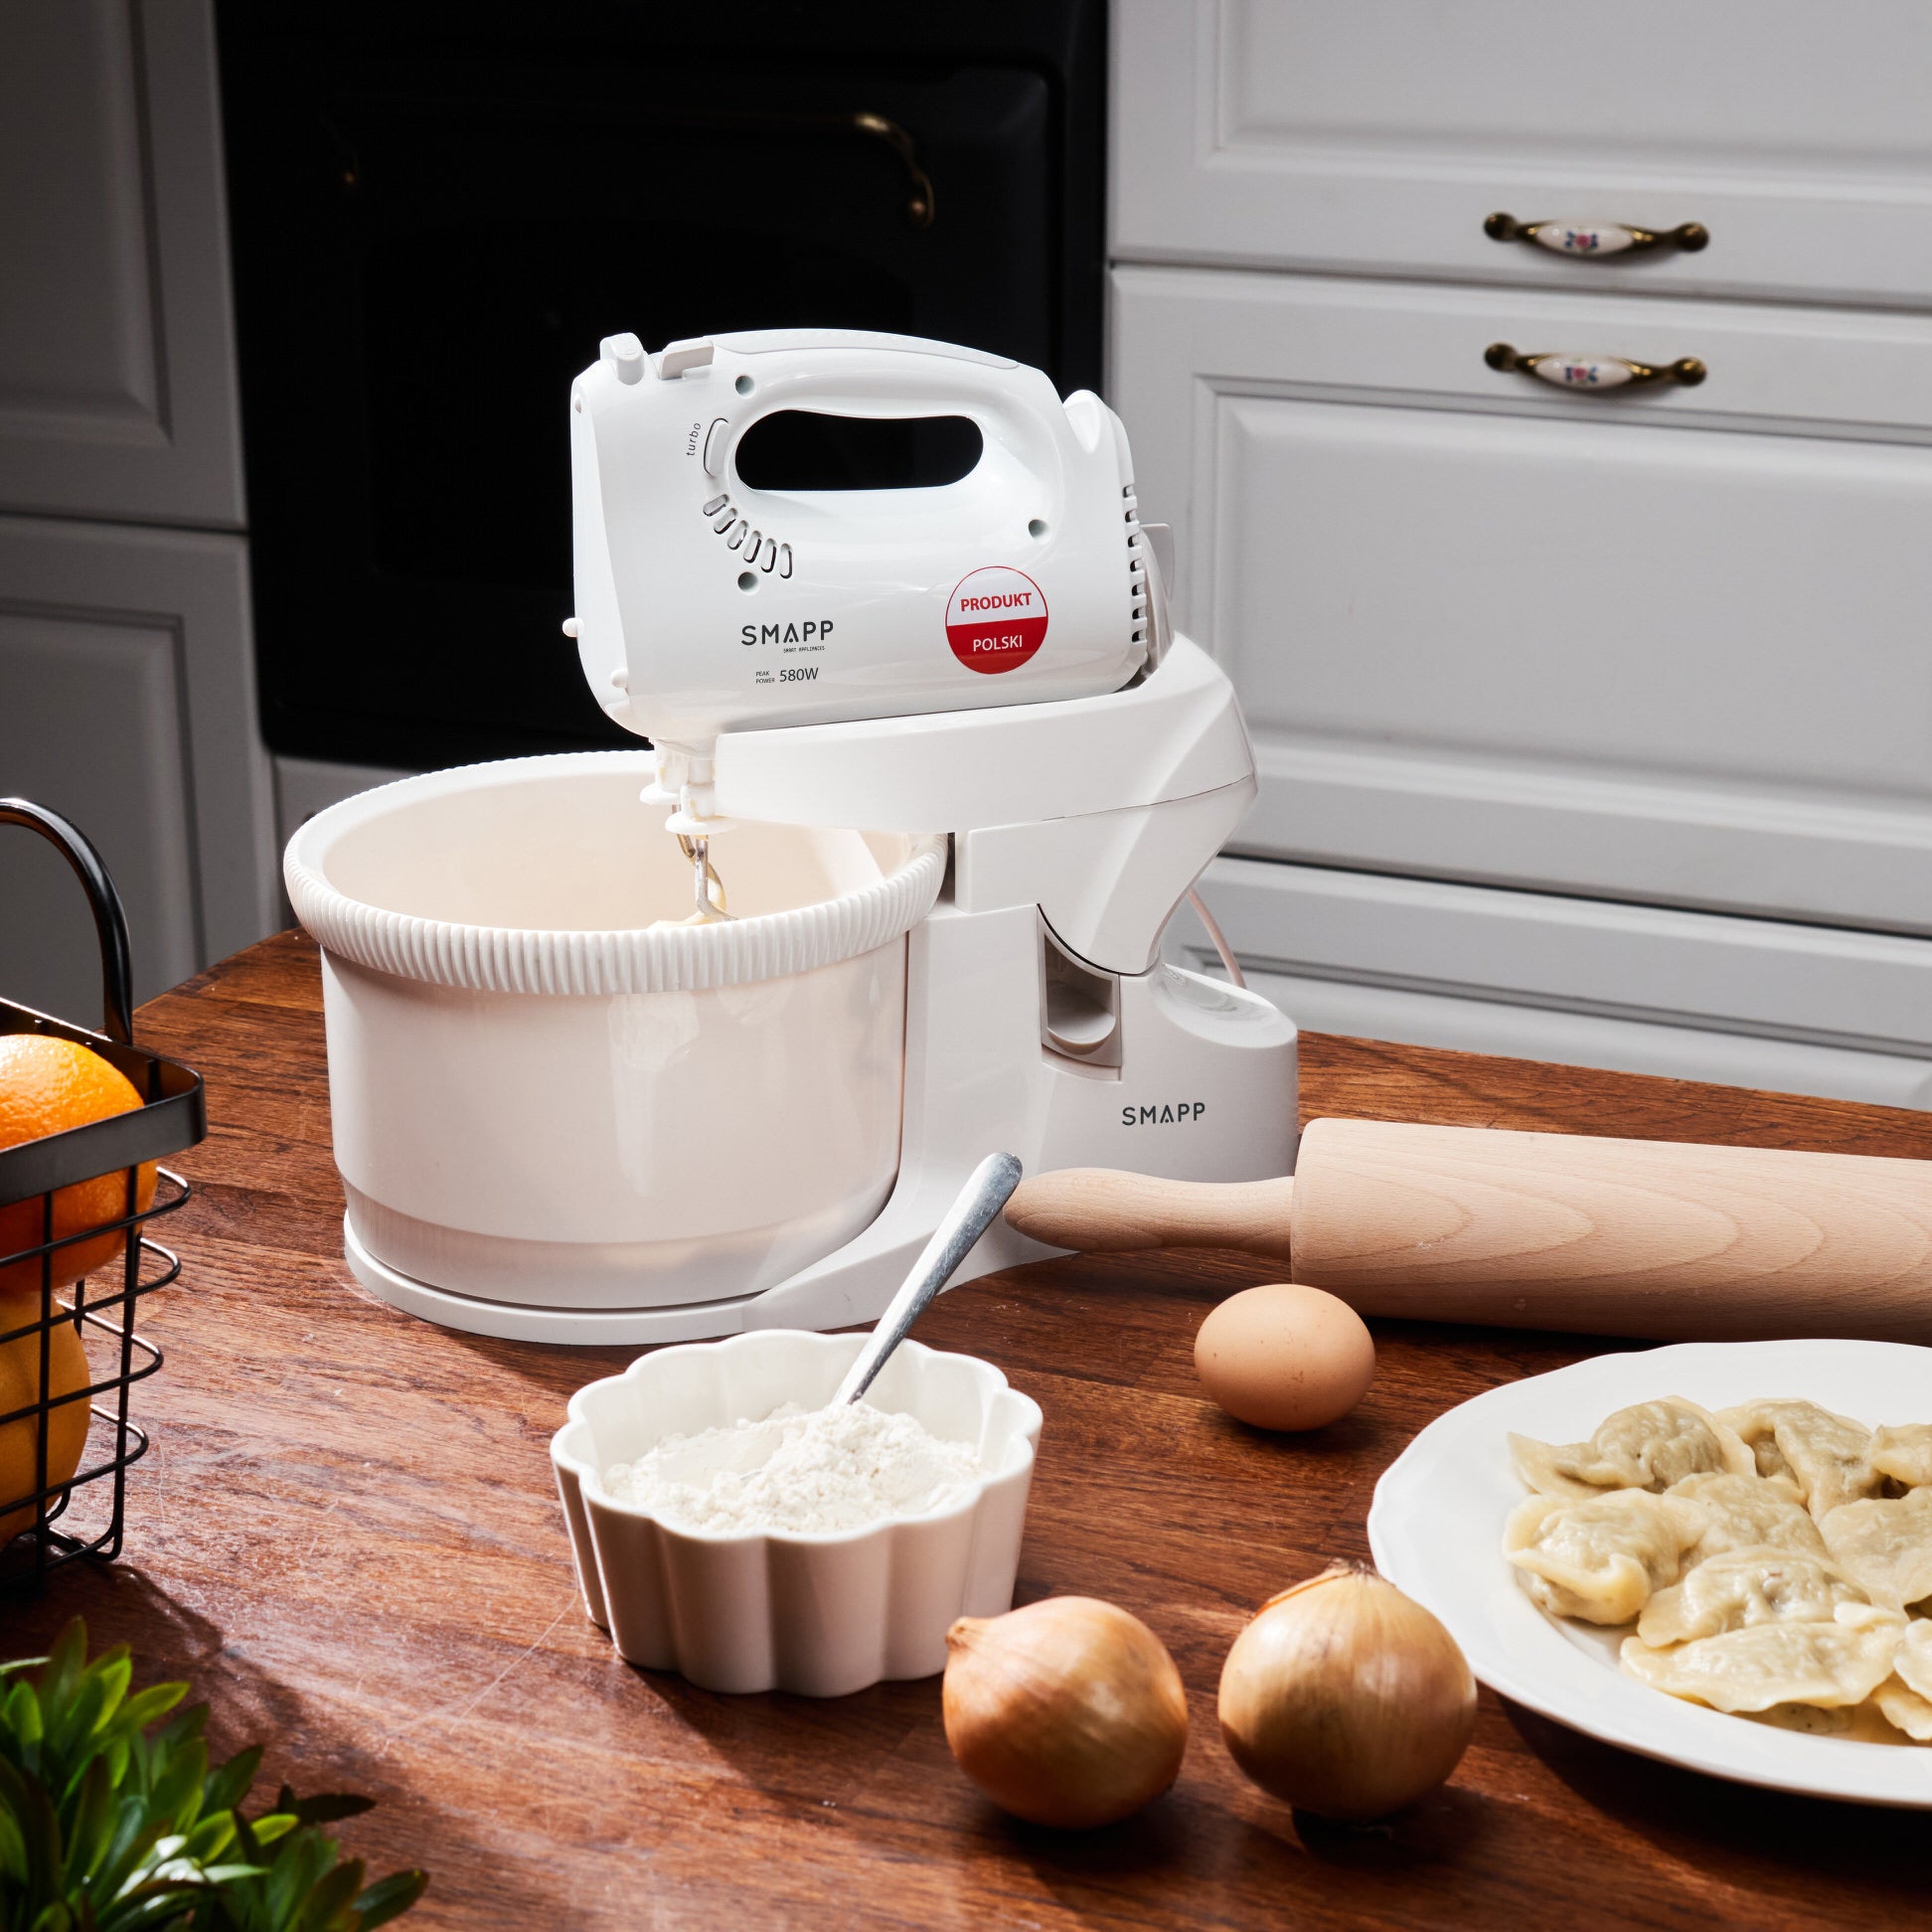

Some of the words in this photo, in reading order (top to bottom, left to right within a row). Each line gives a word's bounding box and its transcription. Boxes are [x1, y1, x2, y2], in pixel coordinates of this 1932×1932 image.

[686, 422, 701, 456] turbo
[960, 592, 1032, 611] PRODUKT
[741, 620, 834, 646] SMAPP
[973, 635, 1023, 652] POLSKI
[779, 667, 819, 683] 580W
[1122, 1102, 1206, 1126] SMAPP
